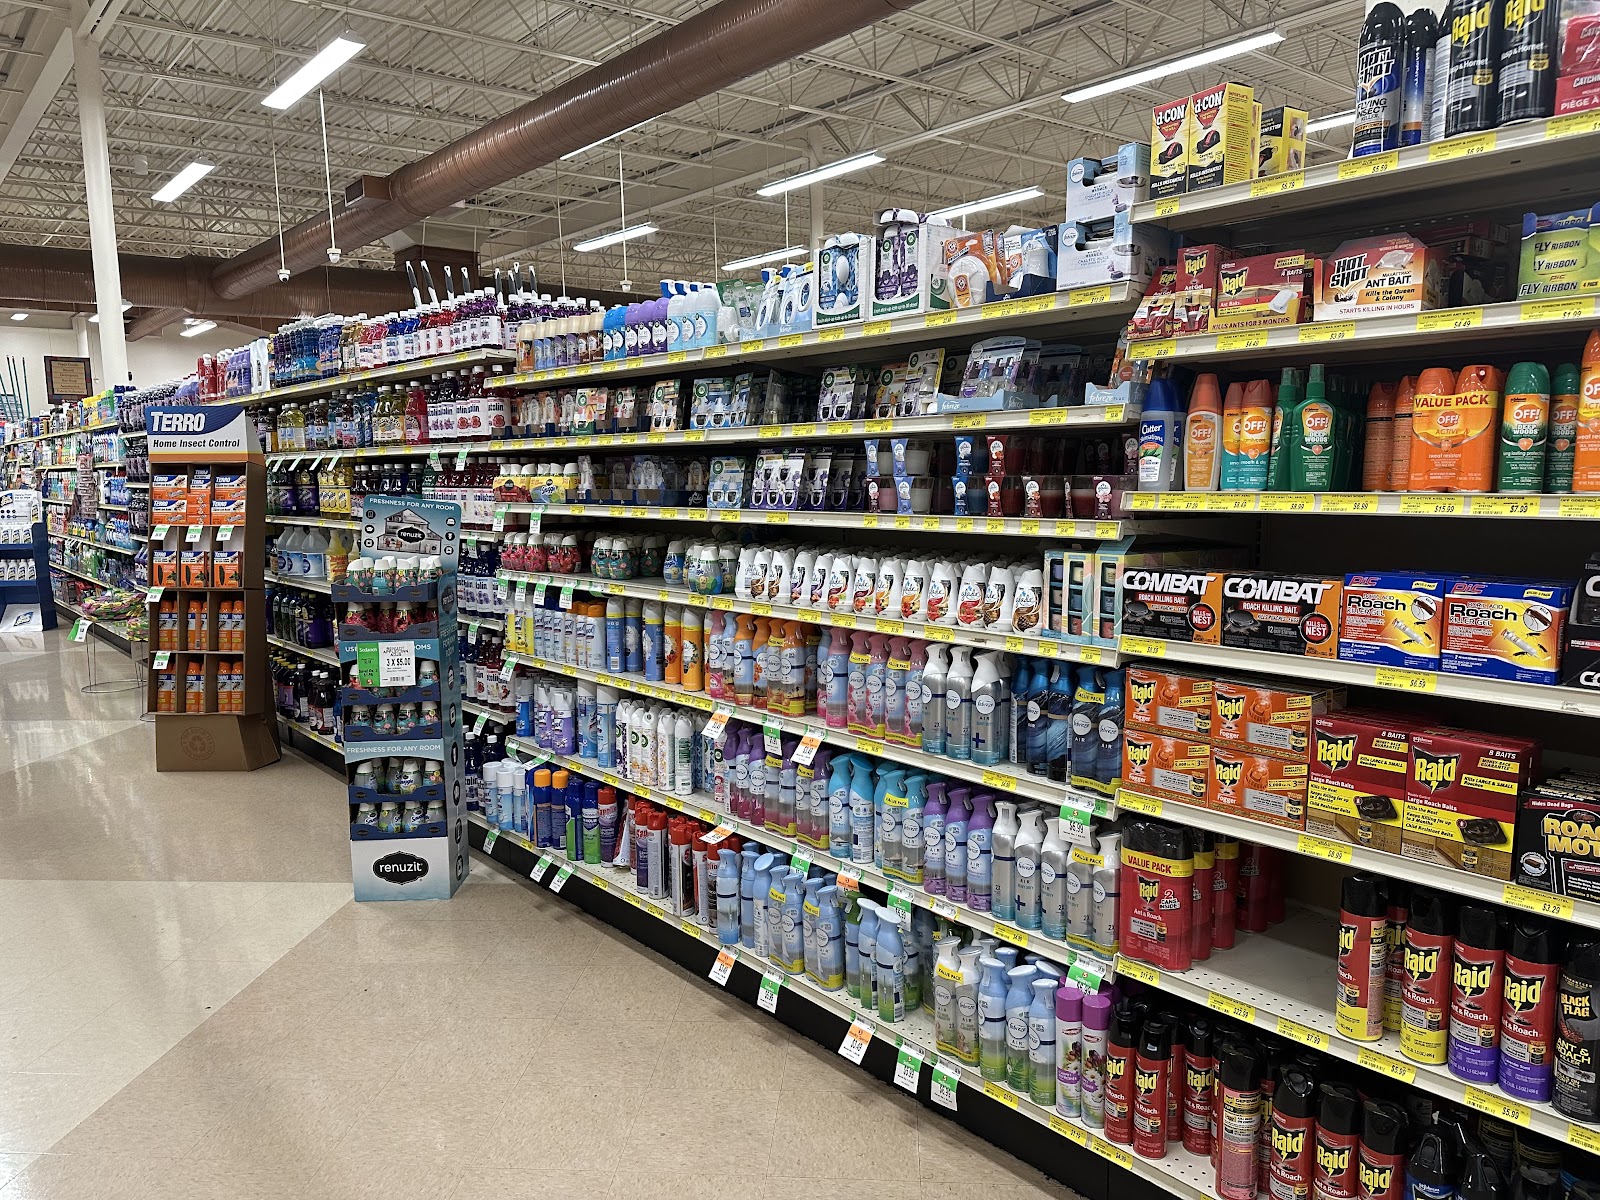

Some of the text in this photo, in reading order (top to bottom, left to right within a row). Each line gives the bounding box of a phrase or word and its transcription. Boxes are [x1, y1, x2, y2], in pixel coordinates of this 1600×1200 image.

[1505, 0, 1545, 30] Raid
[1452, 2, 1491, 44] Raid
[1561, 97, 1590, 111] PIÈGE
[1551, 240, 1581, 250] RIBBON
[1185, 253, 1207, 275] Raid
[1334, 254, 1367, 272] HOT
[1222, 270, 1246, 294] Raid
[1330, 264, 1371, 288] SHOT
[1365, 275, 1411, 288] ANT BAIT
[1366, 289, 1382, 297] Kills
[1396, 287, 1415, 295] Queen
[1520, 282, 1577, 295] FLY RIBBON
[1262, 317, 1290, 326] MONTHS
[1415, 394, 1489, 408] VALUE PACK
[1437, 415, 1459, 424] OFF!
[1513, 408, 1540, 420] OFF!
[1552, 409, 1577, 420] OFF!
[150, 412, 205, 432] TERRO
[1243, 421, 1266, 432] OFF!
[1305, 417, 1329, 428] OFF!
[1141, 424, 1162, 435] Cutter
[1191, 428, 1212, 438] OFF!
[153, 439, 240, 448] Home Insect Control
[369, 498, 405, 506] FRESHNESS
[1434, 505, 1454, 513] $15.99
[1510, 505, 1527, 513] $7.99
[400, 531, 422, 539] renuzit
[1123, 571, 1217, 595] COMBAT
[1224, 578, 1333, 604] COMBAT
[1139, 593, 1153, 601] ROACH
[1155, 595, 1173, 603] KILLING
[1347, 595, 1406, 611] Roach
[1243, 602, 1298, 614] ROACH KILLING BAIT.
[1347, 607, 1384, 616] KILLER GEL
[1450, 603, 1517, 622] Roach
[1193, 616, 1211, 625] NEST
[1449, 617, 1493, 627] KILLER GEL
[1306, 627, 1327, 636] NEST
[1131, 684, 1154, 700] Raid
[1217, 700, 1243, 716] Raid
[1132, 714, 1150, 722] Fogger
[1219, 730, 1239, 739] Fogger
[1387, 732, 1406, 740] BAITS
[347, 746, 385, 754] FRESHNESS
[1128, 745, 1150, 760] Raid
[1317, 739, 1353, 761] Raid
[1495, 751, 1516, 759] BAITS
[1216, 765, 1241, 781] Raid
[1415, 758, 1456, 782] Raid
[1129, 775, 1147, 783] Fogger
[1326, 778, 1340, 787] Roach
[1341, 781, 1354, 789] Baits
[1217, 794, 1237, 804] Fogger
[1407, 795, 1457, 811] Large Roach Baits
[1074, 852, 1102, 865] VALUE PACK
[1128, 855, 1172, 874] VALUE PACK
[379, 862, 422, 873] renuzit
[1139, 882, 1159, 898] Raid
[1164, 889, 1174, 899] 2
[1542, 903, 1560, 914] $3.29
[1147, 911, 1162, 920] Roach
[1404, 950, 1437, 973] Raid
[1454, 963, 1490, 989] Raid
[1505, 976, 1541, 1004] Raid
[1411, 991, 1434, 1005] Roach
[1560, 993, 1590, 1007] BLACK
[1464, 1008, 1488, 1021] Roach
[1563, 1003, 1590, 1017] FLAG
[1187, 1070, 1213, 1088] Raid
[1140, 1104, 1157, 1114] Roach
[1502, 1107, 1520, 1120] $5.99
[1272, 1129, 1304, 1152] Raid
[1317, 1145, 1349, 1169] Raid
[1281, 1170, 1302, 1181] Roach
